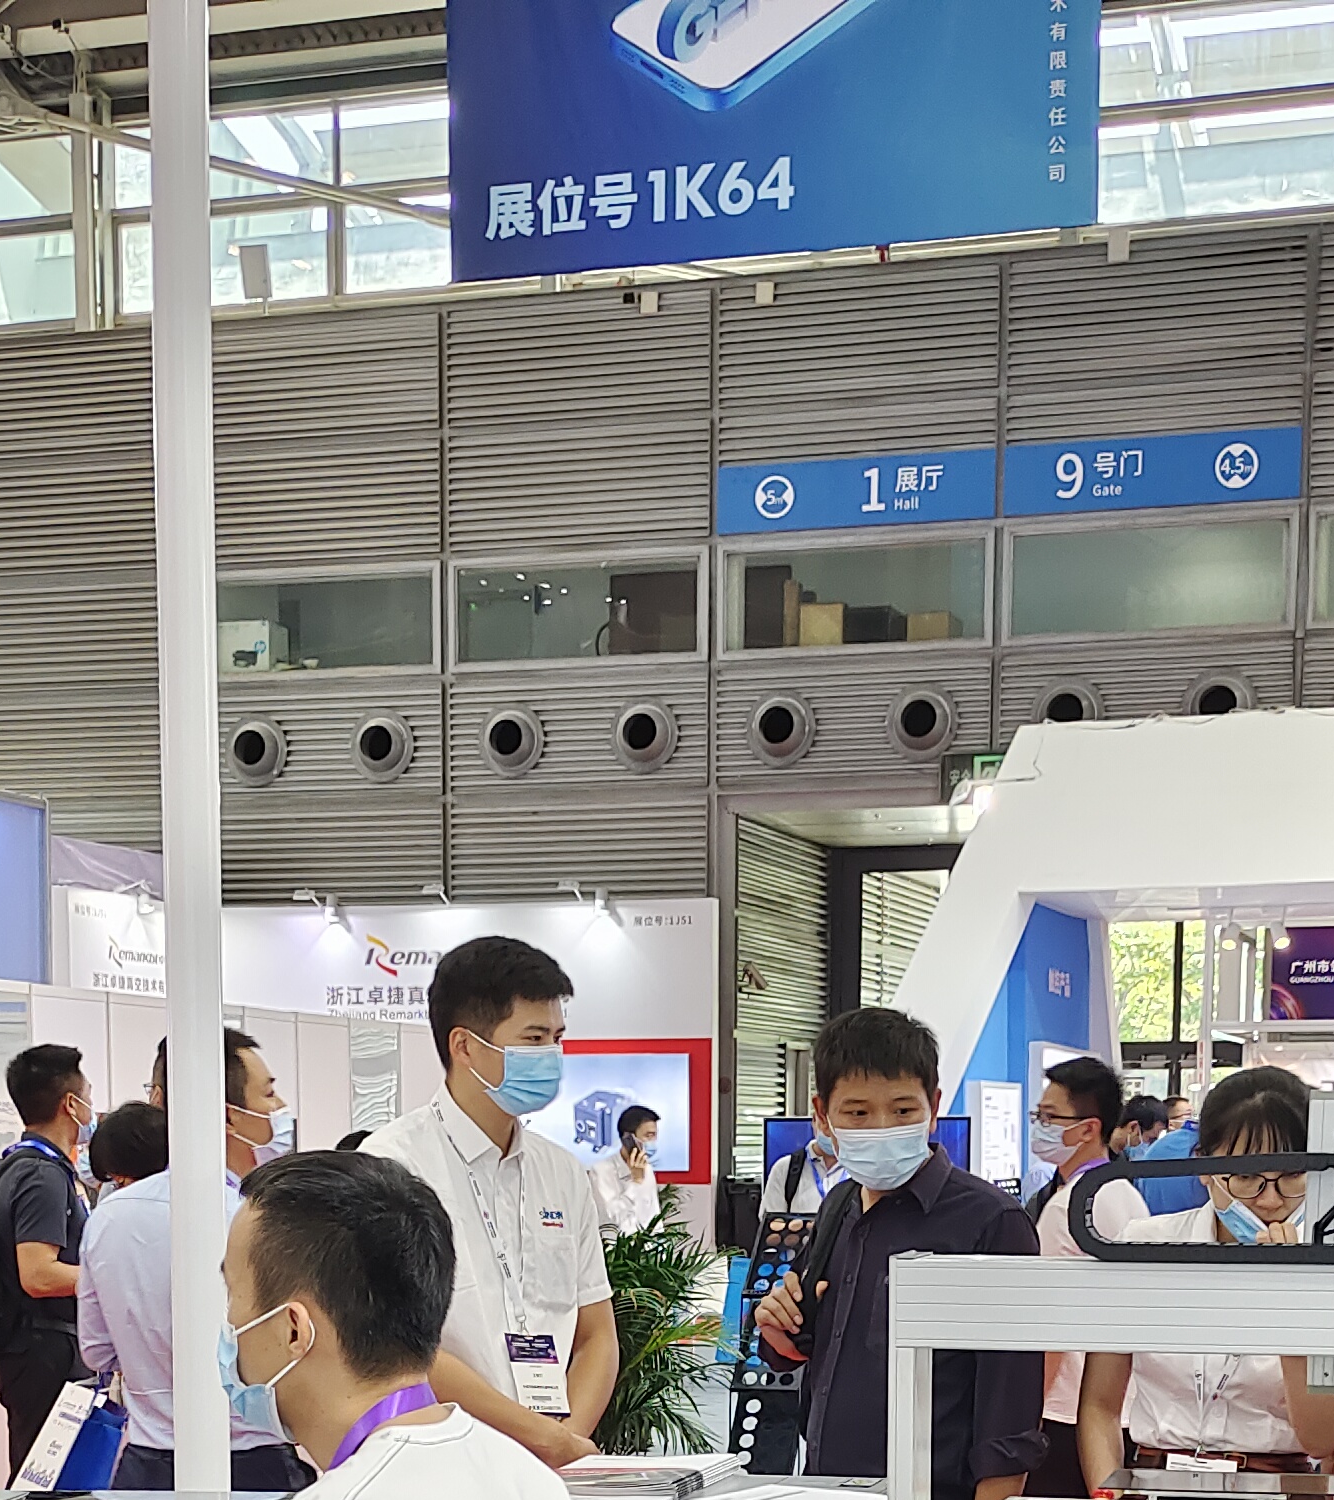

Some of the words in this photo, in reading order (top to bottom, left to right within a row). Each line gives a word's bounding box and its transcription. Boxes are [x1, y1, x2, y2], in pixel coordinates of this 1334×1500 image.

[894, 464, 944, 494] 展厅
[1055, 452, 1085, 499] 9
[1092, 449, 1144, 480] 号门
[861, 467, 887, 512] 1
[894, 496, 920, 512] Hall
[1092, 481, 1124, 498] Gate
